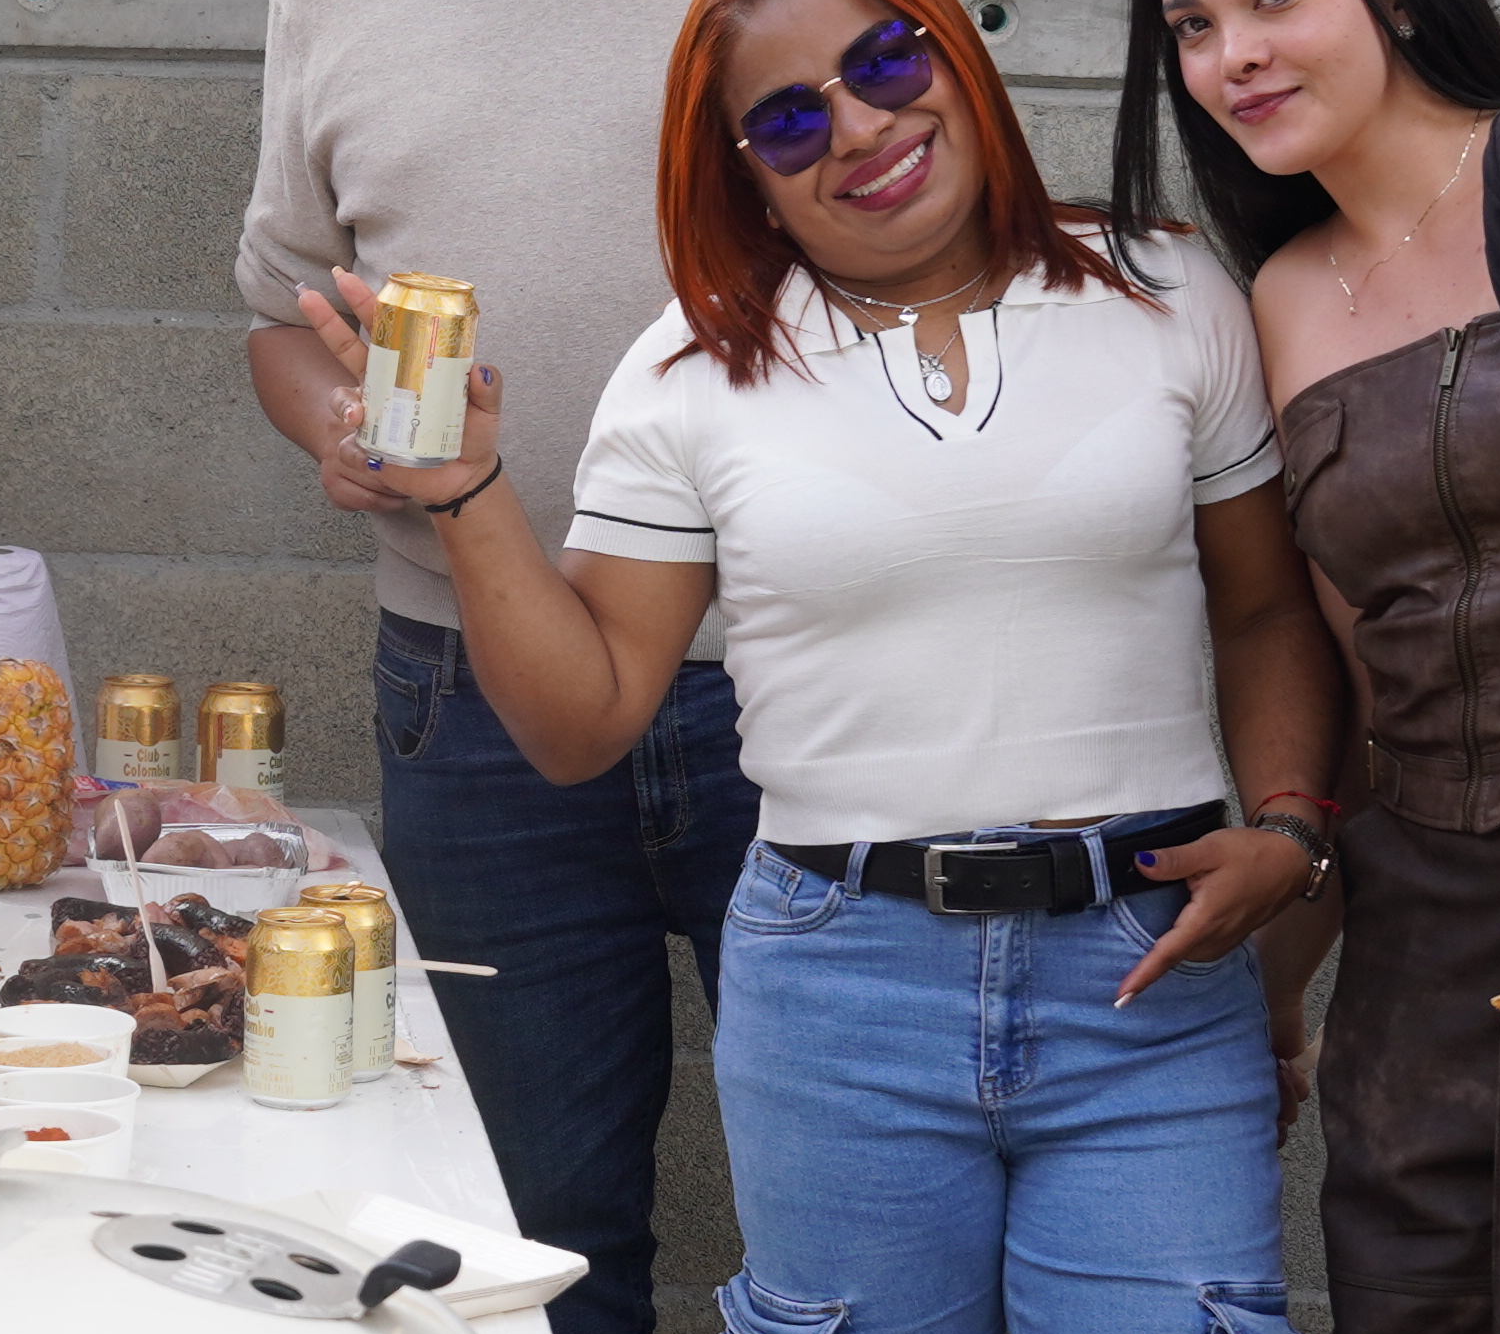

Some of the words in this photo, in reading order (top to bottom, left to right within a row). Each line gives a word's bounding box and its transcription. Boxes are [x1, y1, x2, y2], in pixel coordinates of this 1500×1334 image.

[136, 749, 160, 763] Club
[123, 763, 171, 778] Colombia
[246, 1020, 274, 1038] ombia
